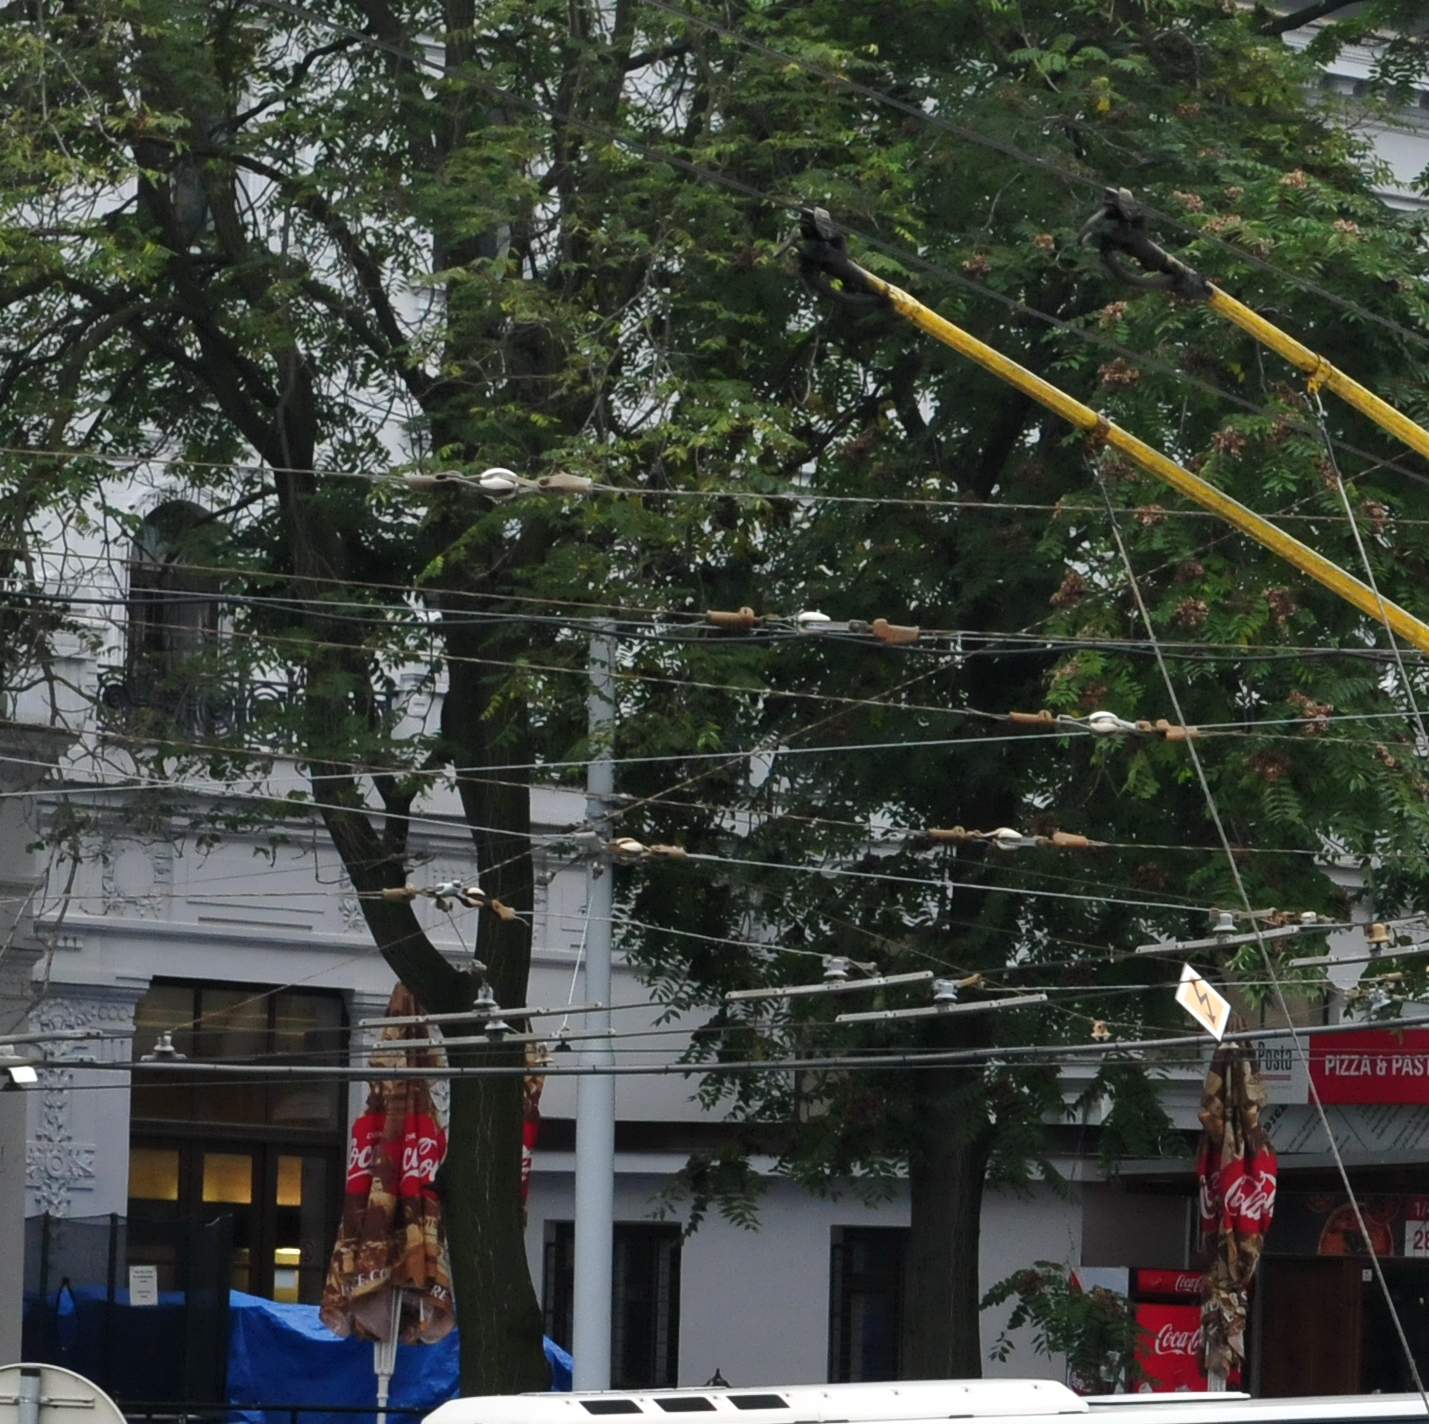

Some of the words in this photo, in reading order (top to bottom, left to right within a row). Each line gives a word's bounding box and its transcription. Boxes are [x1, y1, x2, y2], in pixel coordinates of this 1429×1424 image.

[1258, 1041, 1293, 1071] Posta
[1325, 1055, 1371, 1076] PIZZA
[1376, 1056, 1387, 1076] &
